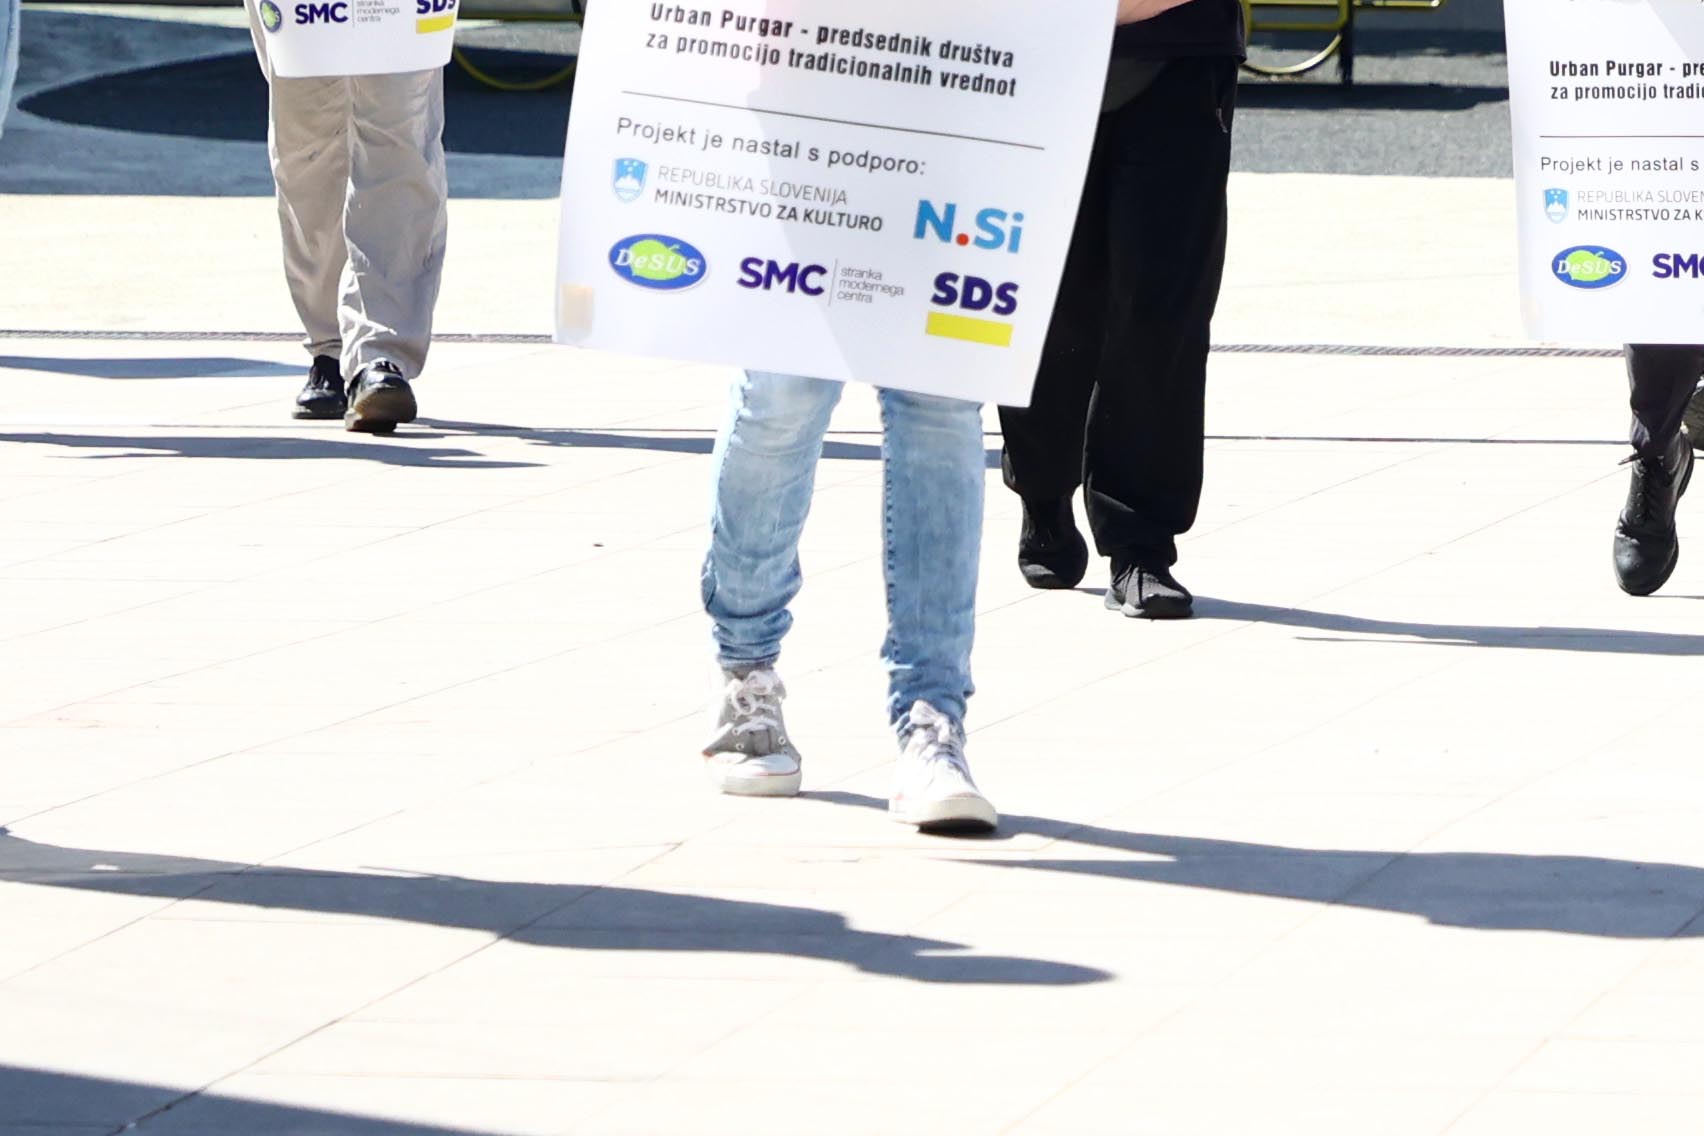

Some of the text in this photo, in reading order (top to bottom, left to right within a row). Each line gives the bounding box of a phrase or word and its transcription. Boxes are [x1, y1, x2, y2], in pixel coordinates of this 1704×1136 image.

[295, 1, 348, 24] SMC
[651, 3, 711, 26] Urban
[721, 10, 793, 38] Purgar
[816, 26, 932, 57] predsednik
[939, 40, 1013, 67] društva
[646, 33, 1016, 96] za promocijo tradicionalnih vrednot
[1550, 61, 1598, 76] Urban
[1606, 60, 1662, 78] Purgar
[1551, 87, 1568, 99] za
[1575, 83, 1656, 101] promocijo
[617, 117, 925, 175] Projekt je nastal s podporo:
[1541, 157, 1601, 174] Projekt
[1608, 160, 1623, 174] je
[1632, 157, 1683, 171] nastal
[1691, 160, 1699, 171] s
[658, 165, 847, 206] REPUBLIKA SLOVENIJA
[1578, 190, 1654, 203] REPUBLIKA
[655, 189, 883, 231] MINISTRSTVO ZA KULTURO
[1578, 209, 1670, 220] MINISTRSTVO
[1674, 209, 1691, 220] ZA
[913, 200, 1025, 254] N.Si
[736, 256, 828, 297] SMC
[840, 267, 883, 281] stranka
[837, 290, 872, 304] centra
[930, 272, 1019, 316] SDS
